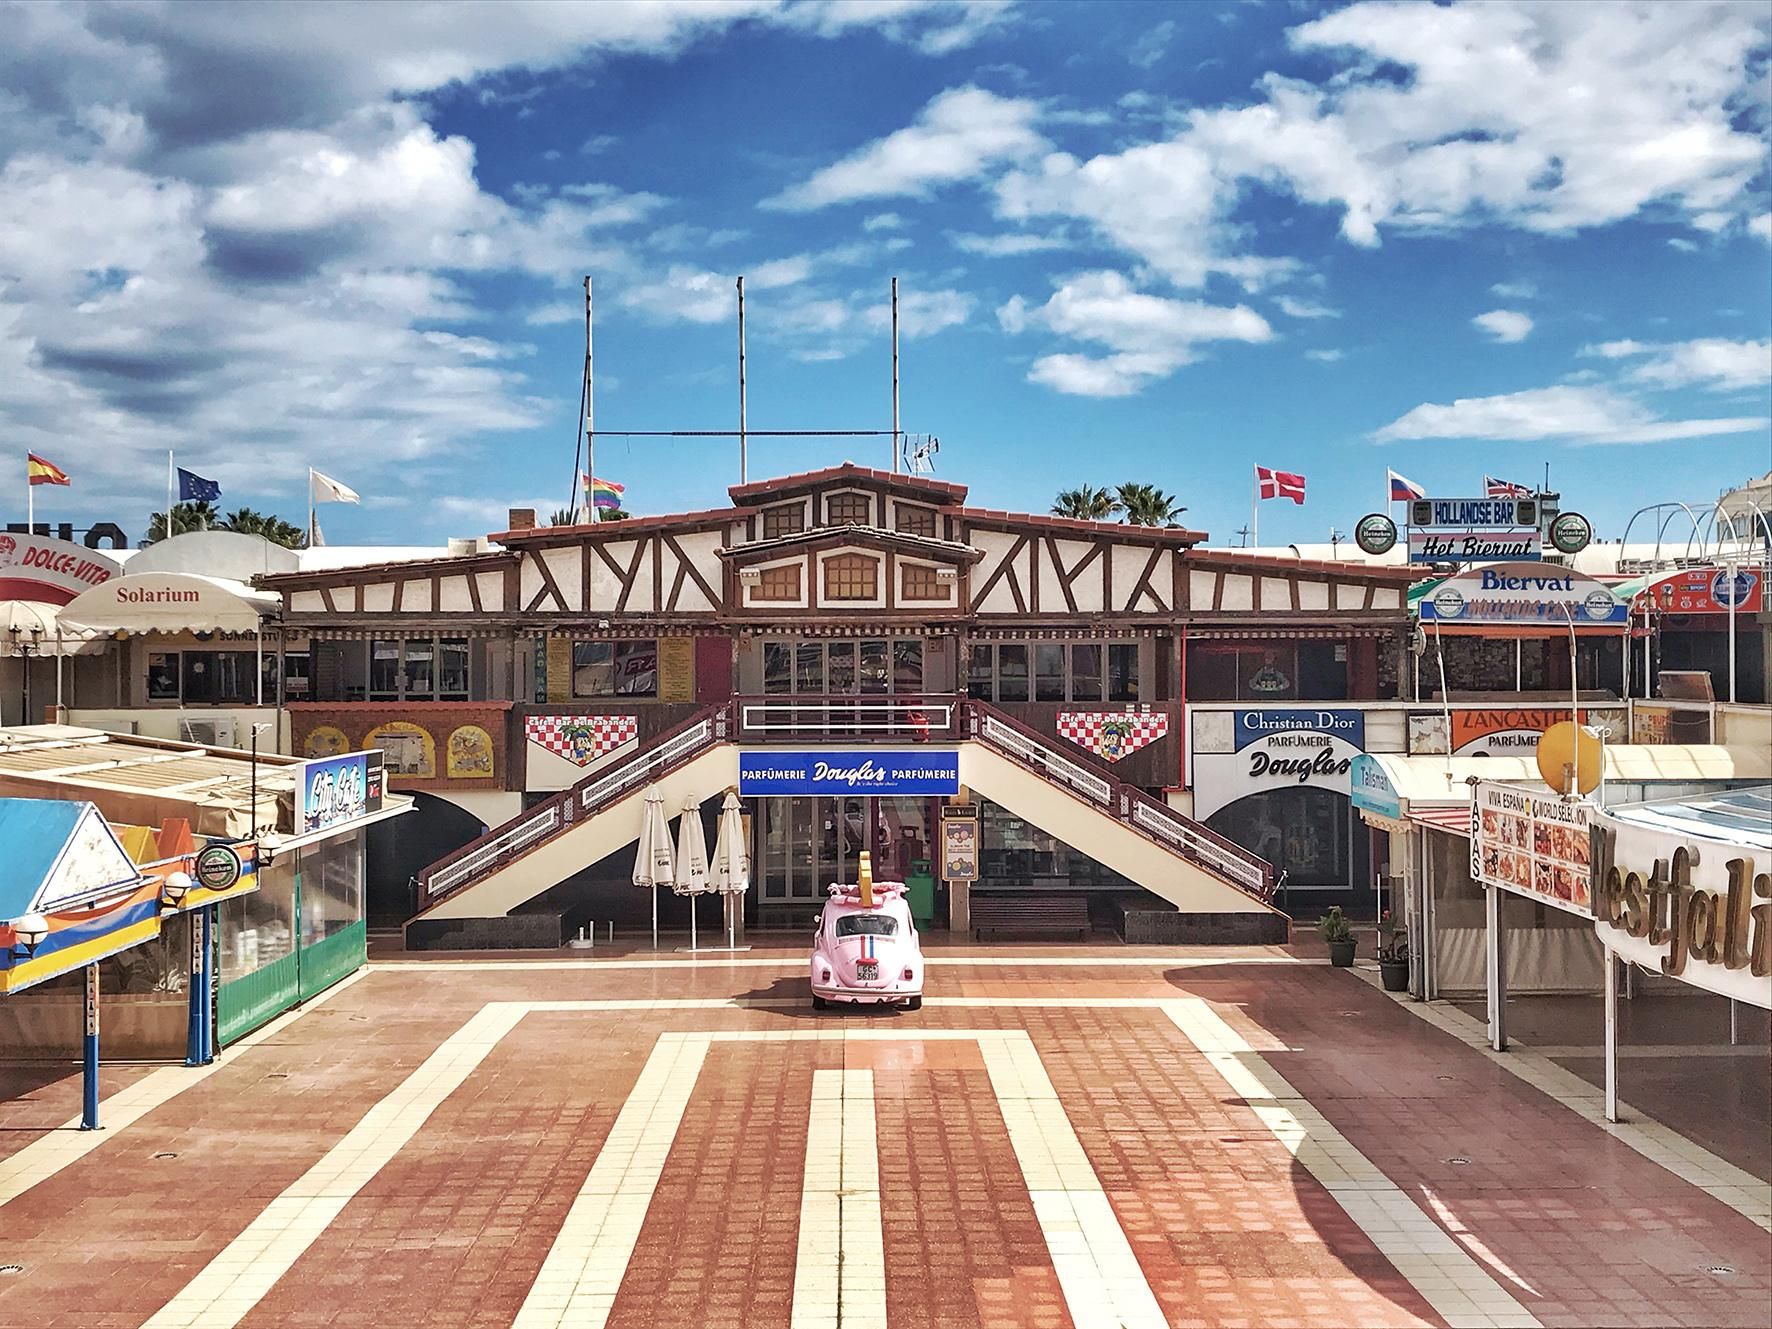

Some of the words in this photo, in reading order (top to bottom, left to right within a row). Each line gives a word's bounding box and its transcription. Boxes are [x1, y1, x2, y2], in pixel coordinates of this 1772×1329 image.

[1434, 502, 1491, 524] HOLLANDSE
[1493, 501, 1514, 524] BAR
[1422, 536, 1455, 558] Het
[1461, 535, 1534, 558] Biervat
[22, 546, 111, 586] DOLCE-VITA
[1480, 570, 1575, 592] Biervat
[117, 587, 200, 603] Solarium
[1243, 711, 1312, 730] Christian
[1315, 711, 1356, 729] Dior
[1267, 735, 1333, 747] PARFÜMERIE
[1488, 735, 1539, 747] PARFÜME
[741, 767, 806, 780] PARFÜMERIE
[812, 760, 887, 787] Douglas
[891, 767, 956, 780] PARFÜMERIE
[1249, 747, 1352, 783] Douglas
[1360, 766, 1388, 792] Talisman
[1488, 790, 1502, 807] VIVA
[1503, 792, 1524, 813] ESPAÑA
[1539, 802, 1557, 820] WORLD
[1472, 781, 1480, 878] TAPAS
